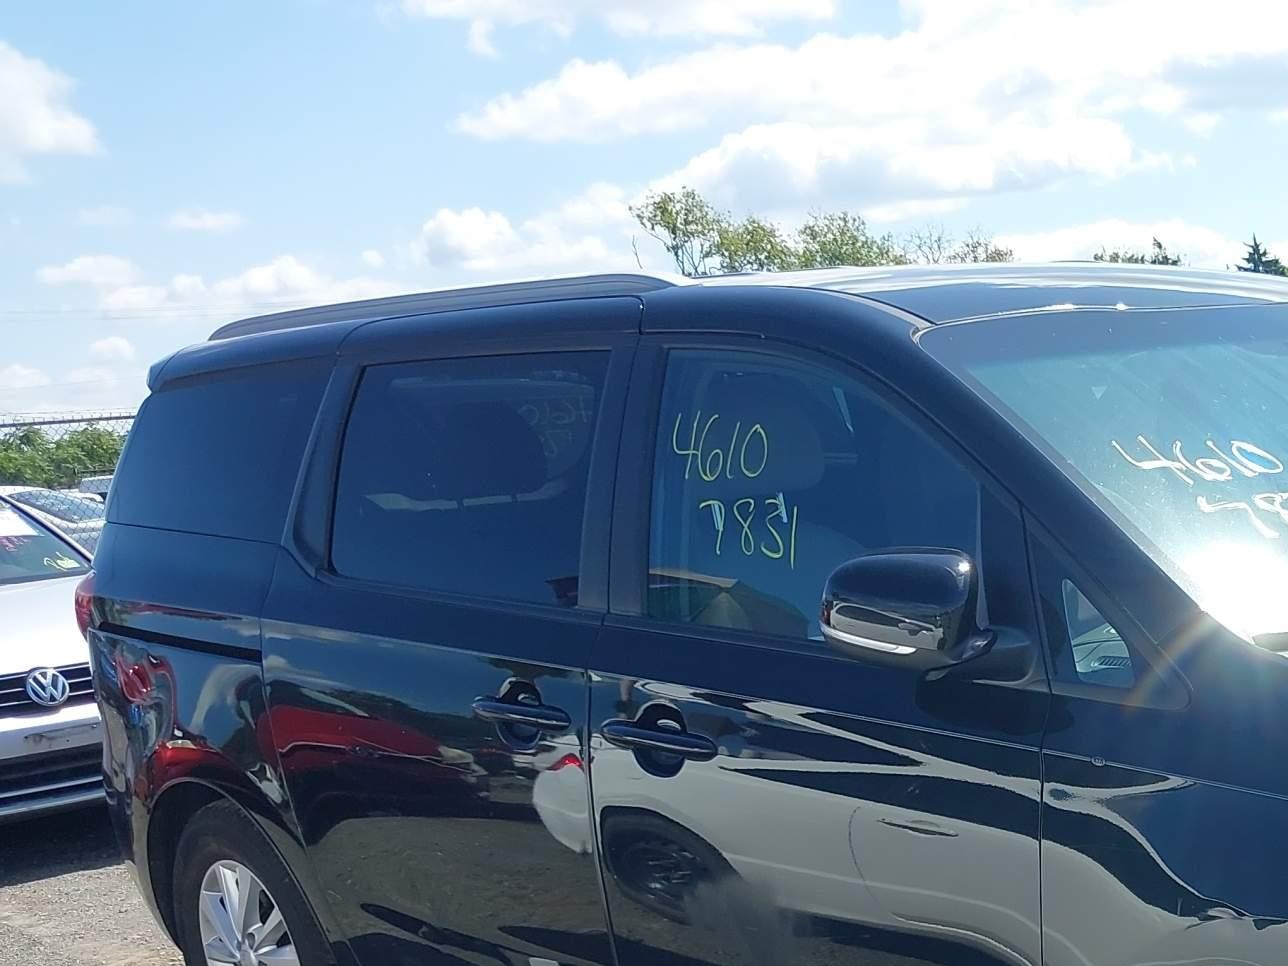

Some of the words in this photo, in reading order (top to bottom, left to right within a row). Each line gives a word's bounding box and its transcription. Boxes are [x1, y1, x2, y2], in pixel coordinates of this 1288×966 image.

[672, 410, 769, 482] 4610
[1110, 434, 1285, 486] 4610
[698, 491, 799, 570] 7831
